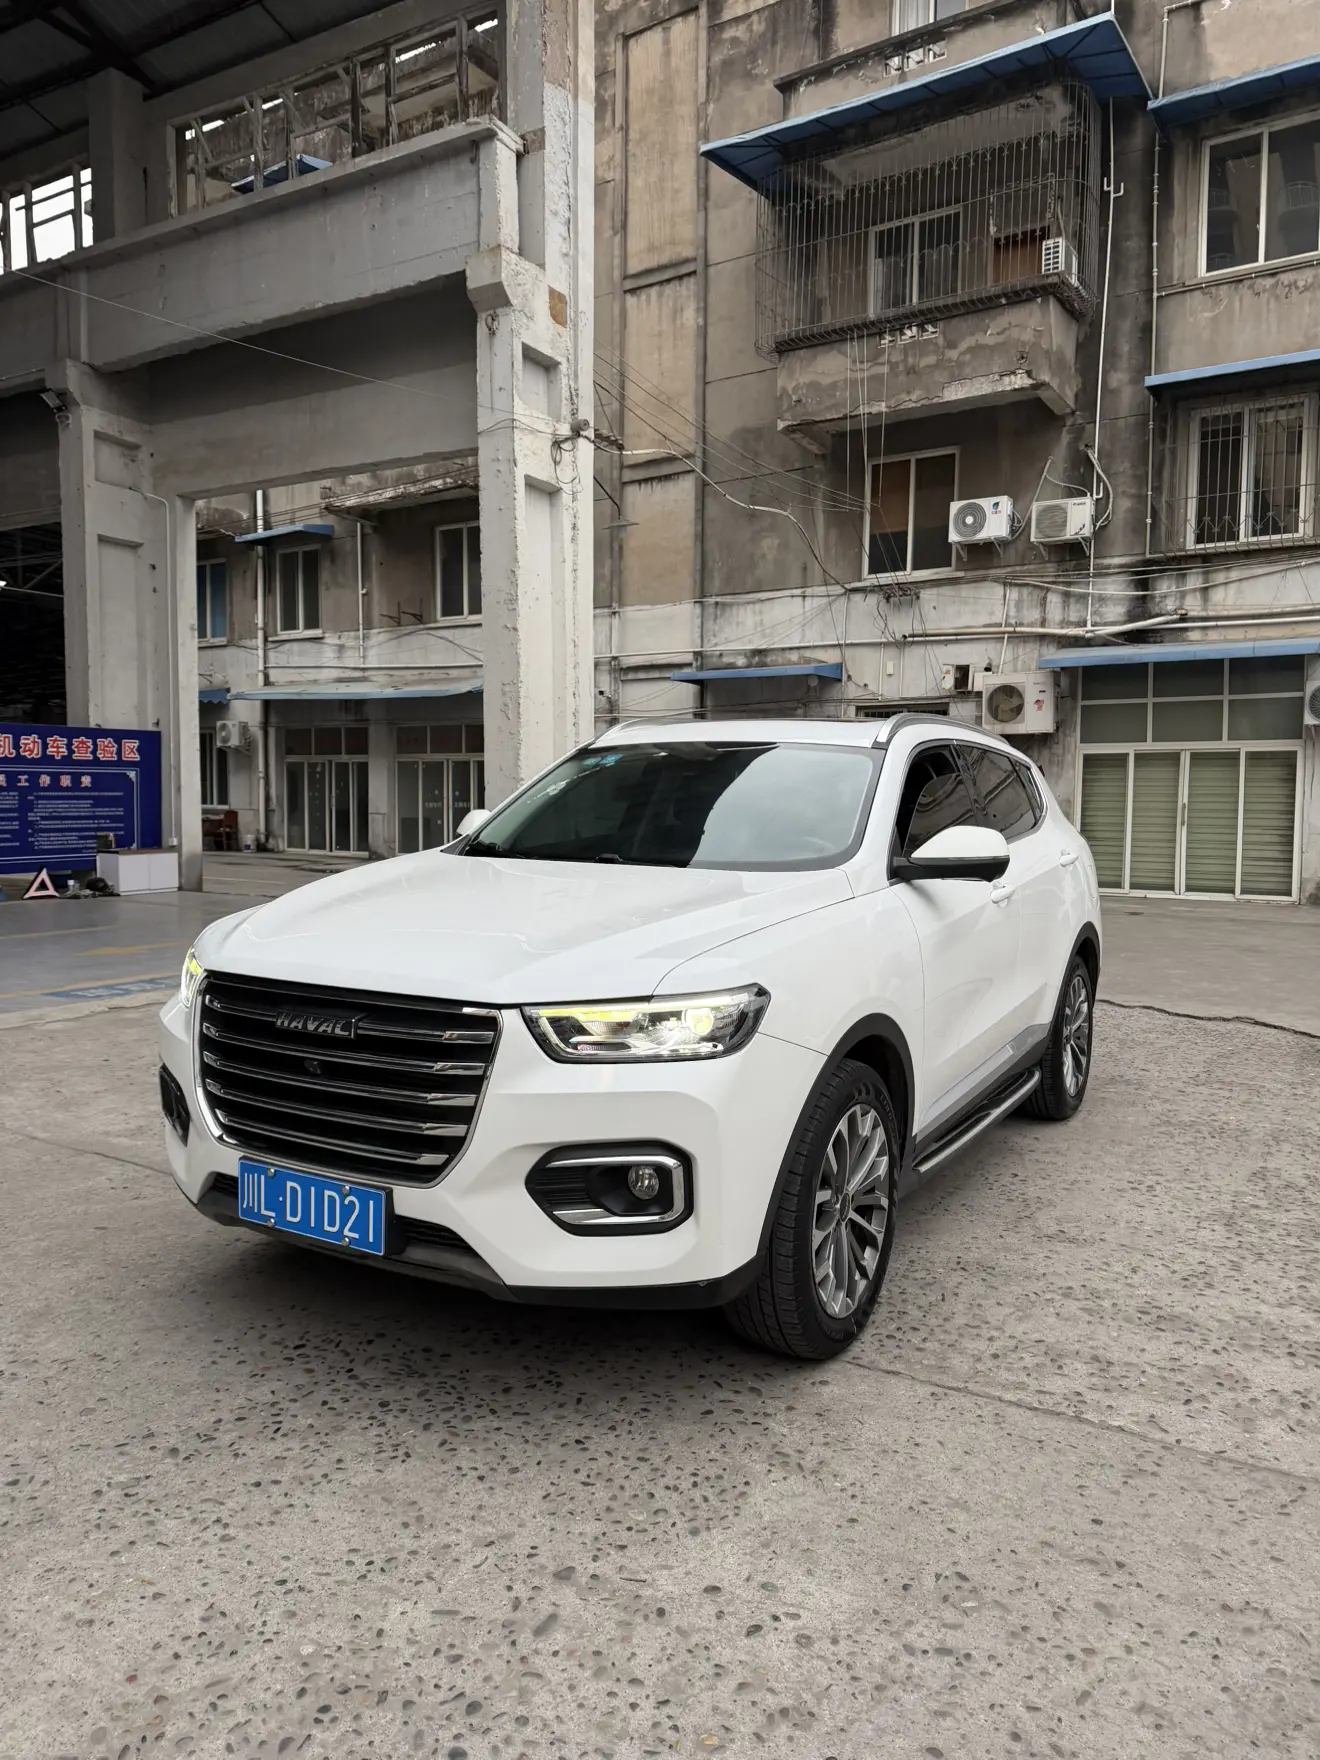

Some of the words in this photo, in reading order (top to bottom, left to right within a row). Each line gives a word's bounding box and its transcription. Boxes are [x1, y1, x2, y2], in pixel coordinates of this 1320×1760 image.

[0, 733, 141, 762] 机动车查验区
[276, 1011, 350, 1036] HAVAL
